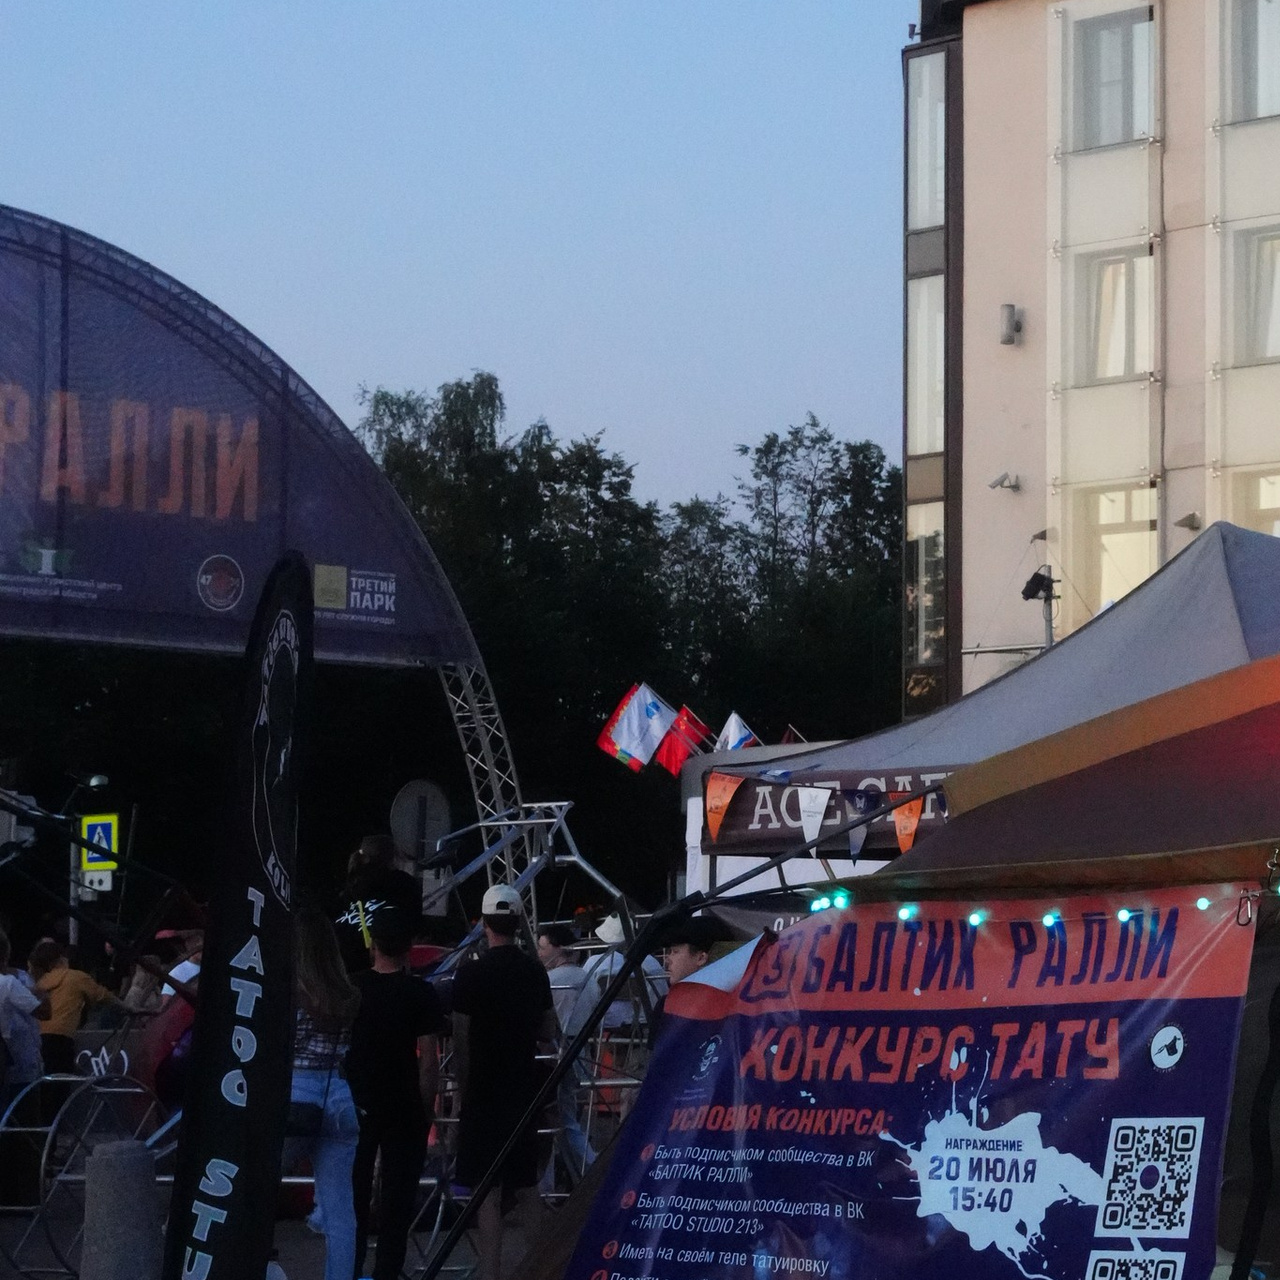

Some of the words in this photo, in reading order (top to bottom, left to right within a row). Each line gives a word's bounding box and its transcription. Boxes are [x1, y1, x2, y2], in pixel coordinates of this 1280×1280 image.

[0, 381, 260, 522] РАЛЛИ
[350, 576, 396, 594] ТРЕТИЙ
[350, 591, 396, 612] ПАРК
[1007, 907, 1180, 989] РАЛЛИ
[739, 1023, 975, 1084] КОНКУРС
[991, 1018, 1121, 1081] ТАТУ
[668, 1103, 763, 1132] УСЛОВИЯ
[654, 1144, 682, 1160] Быть
[684, 1146, 765, 1163] подписчиком
[767, 1145, 844, 1167] сообщества
[846, 1154, 855, 1167] в
[857, 1150, 876, 1167] ВК
[945, 1138, 1023, 1151] НАГРАЖДЕНИЕ
[648, 1163, 703, 1181] «БАЛТИК
[706, 1166, 754, 1183] РАЛЛИ»
[928, 1155, 960, 1181] 20
[968, 1157, 1037, 1183] ИЮЛЯ
[636, 1192, 665, 1209] Быть
[667, 1195, 750, 1212] подписчиком
[752, 1198, 830, 1217] сообщества
[834, 1204, 843, 1218] в
[847, 1201, 865, 1219] ВК
[949, 1186, 1013, 1213] 15:40
[631, 1212, 683, 1230] «TATTOO
[686, 1216, 735, 1234] STUDIO
[735, 1218, 765, 1235] 213»
[619, 1242, 654, 1260] Иметь
[656, 1246, 673, 1261] на
[677, 1247, 714, 1264] своём
[718, 1251, 747, 1266] теле
[752, 1254, 830, 1276] татуировку
